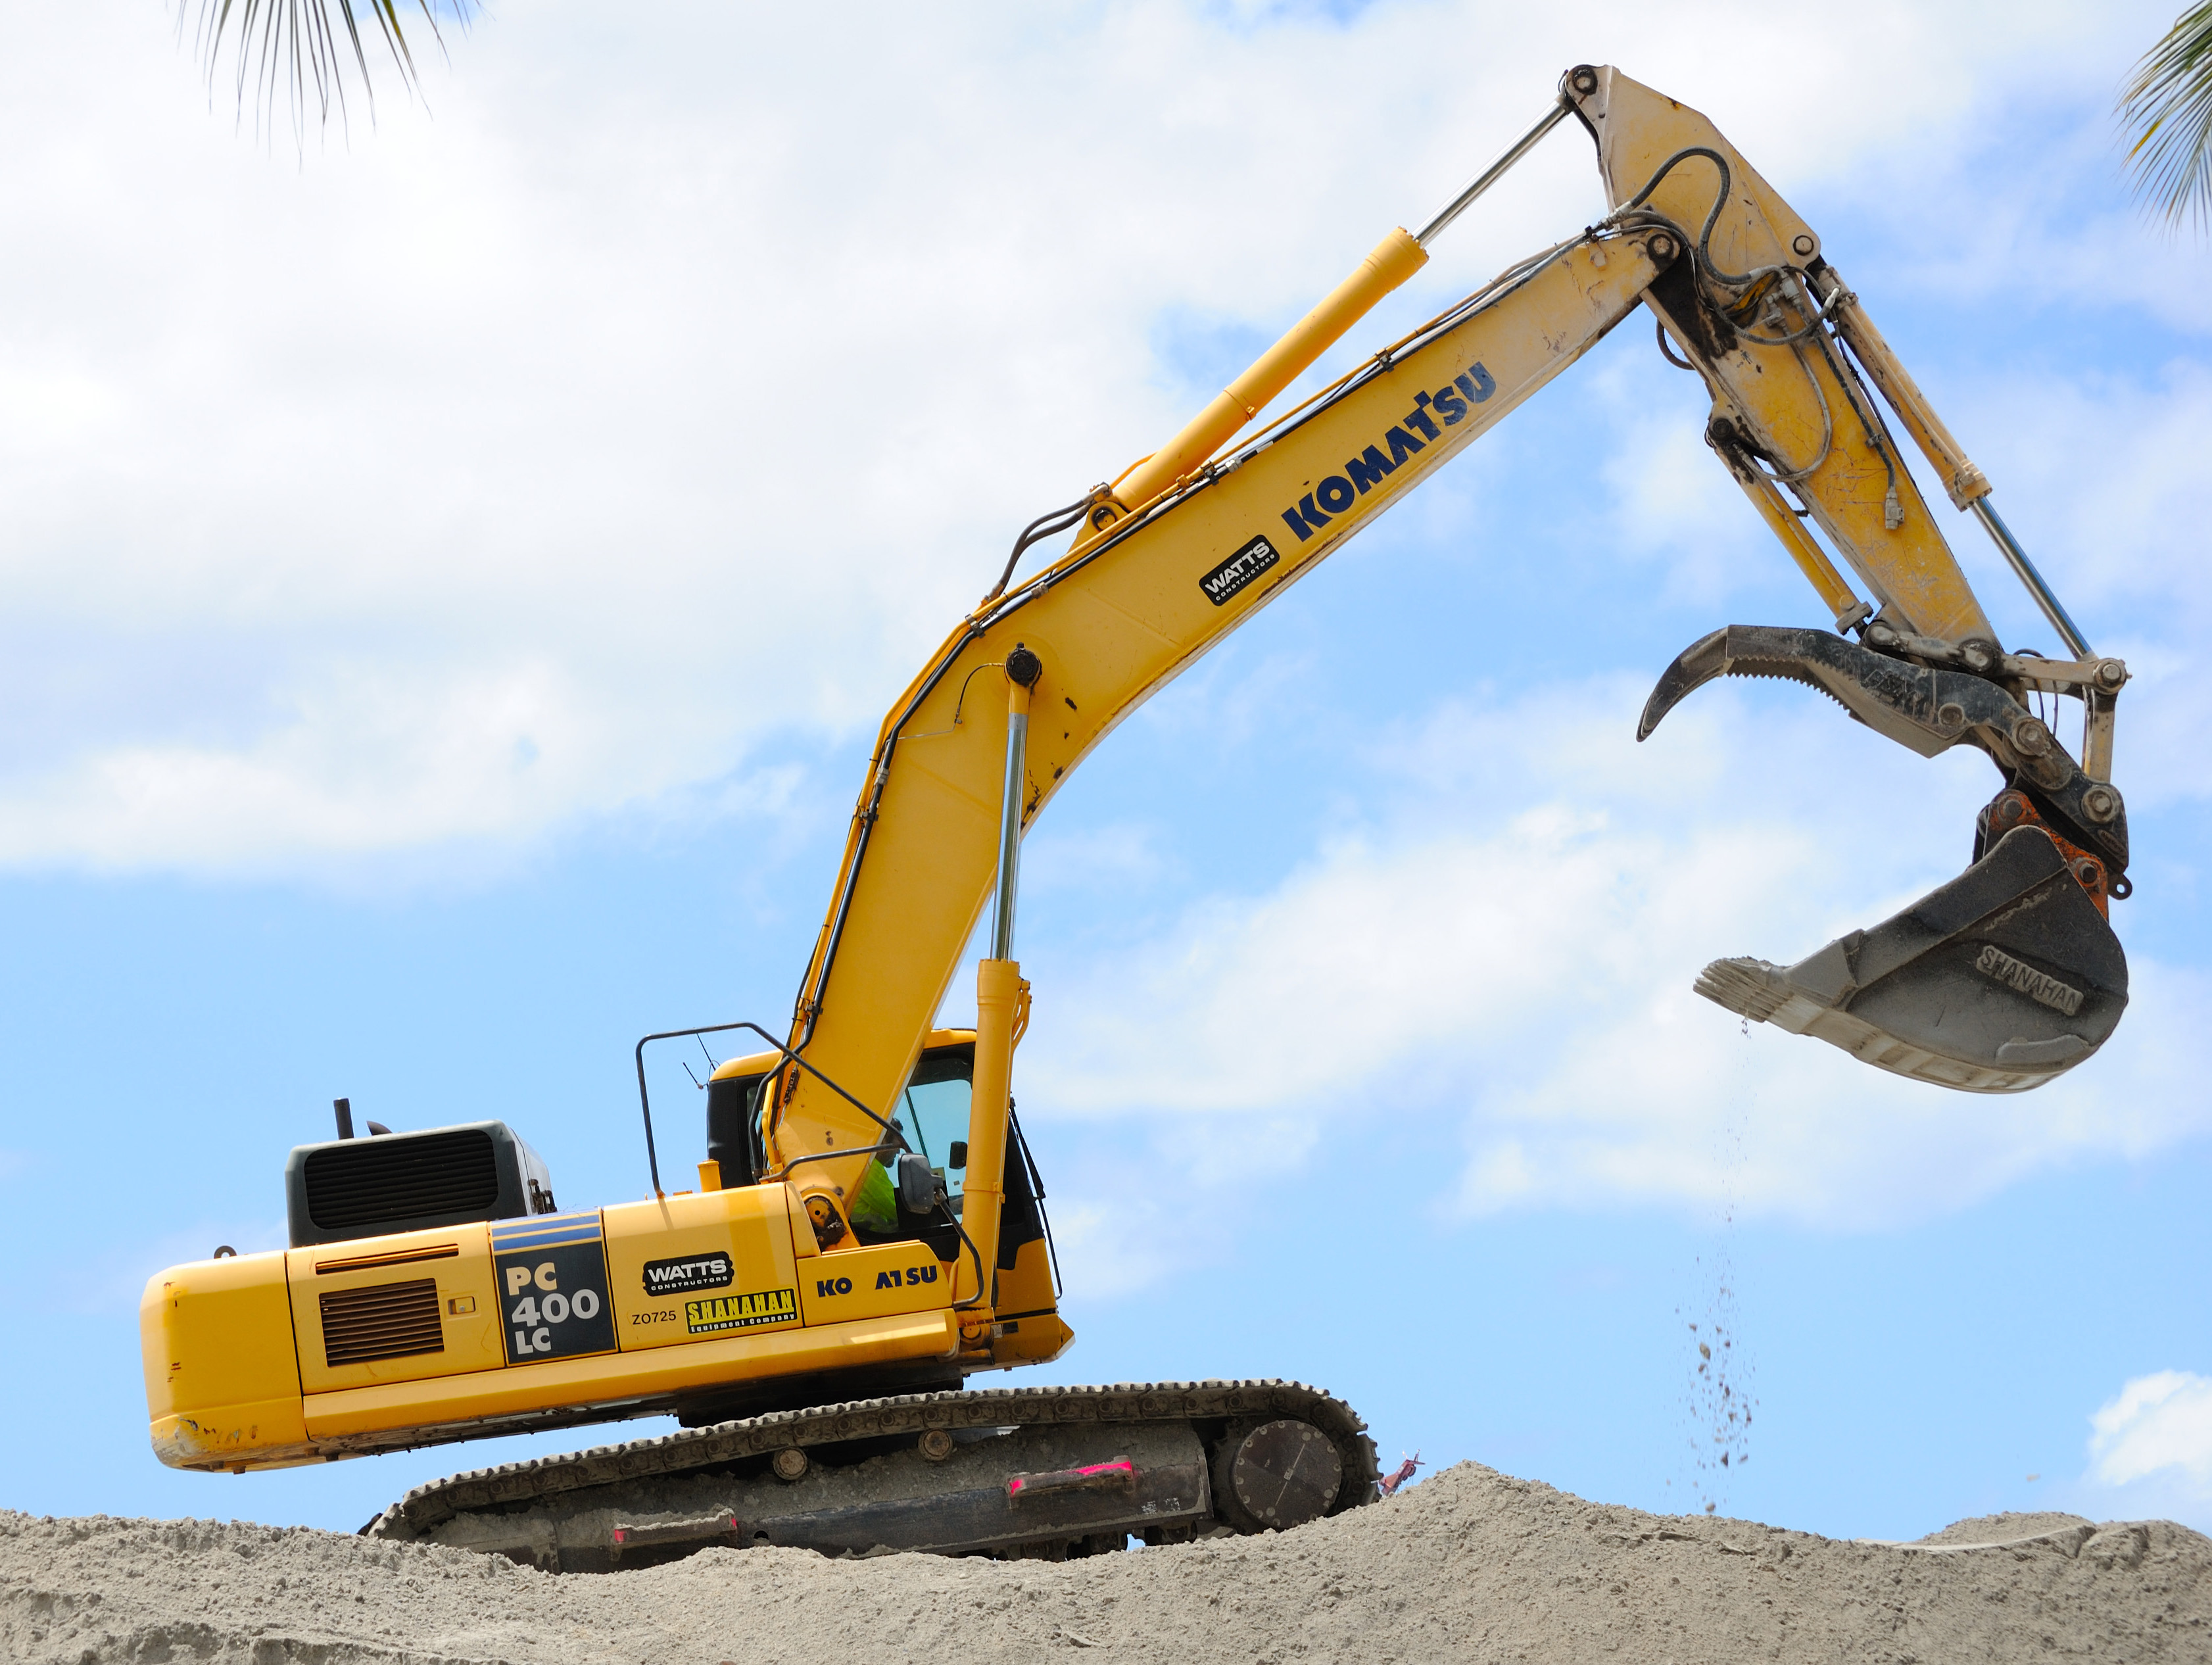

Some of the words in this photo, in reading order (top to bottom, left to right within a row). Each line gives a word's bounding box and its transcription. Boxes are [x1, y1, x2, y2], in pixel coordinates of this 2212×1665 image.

[1281, 361, 1497, 543] KOMATSU
[1205, 541, 1270, 594] WATTS
[1215, 553, 1275, 601] CONSTRUCTORS
[1979, 947, 2080, 1011] SHANAHAN
[506, 1262, 558, 1296] PC
[648, 1259, 727, 1282] WATTS
[651, 1276, 728, 1291] CONSTRUCTORS
[512, 1288, 600, 1327] 400
[687, 1290, 794, 1326] SHANAHAN
[691, 1319, 745, 1333] Equipment
[750, 1313, 794, 1325] Company
[515, 1327, 552, 1355] LC
